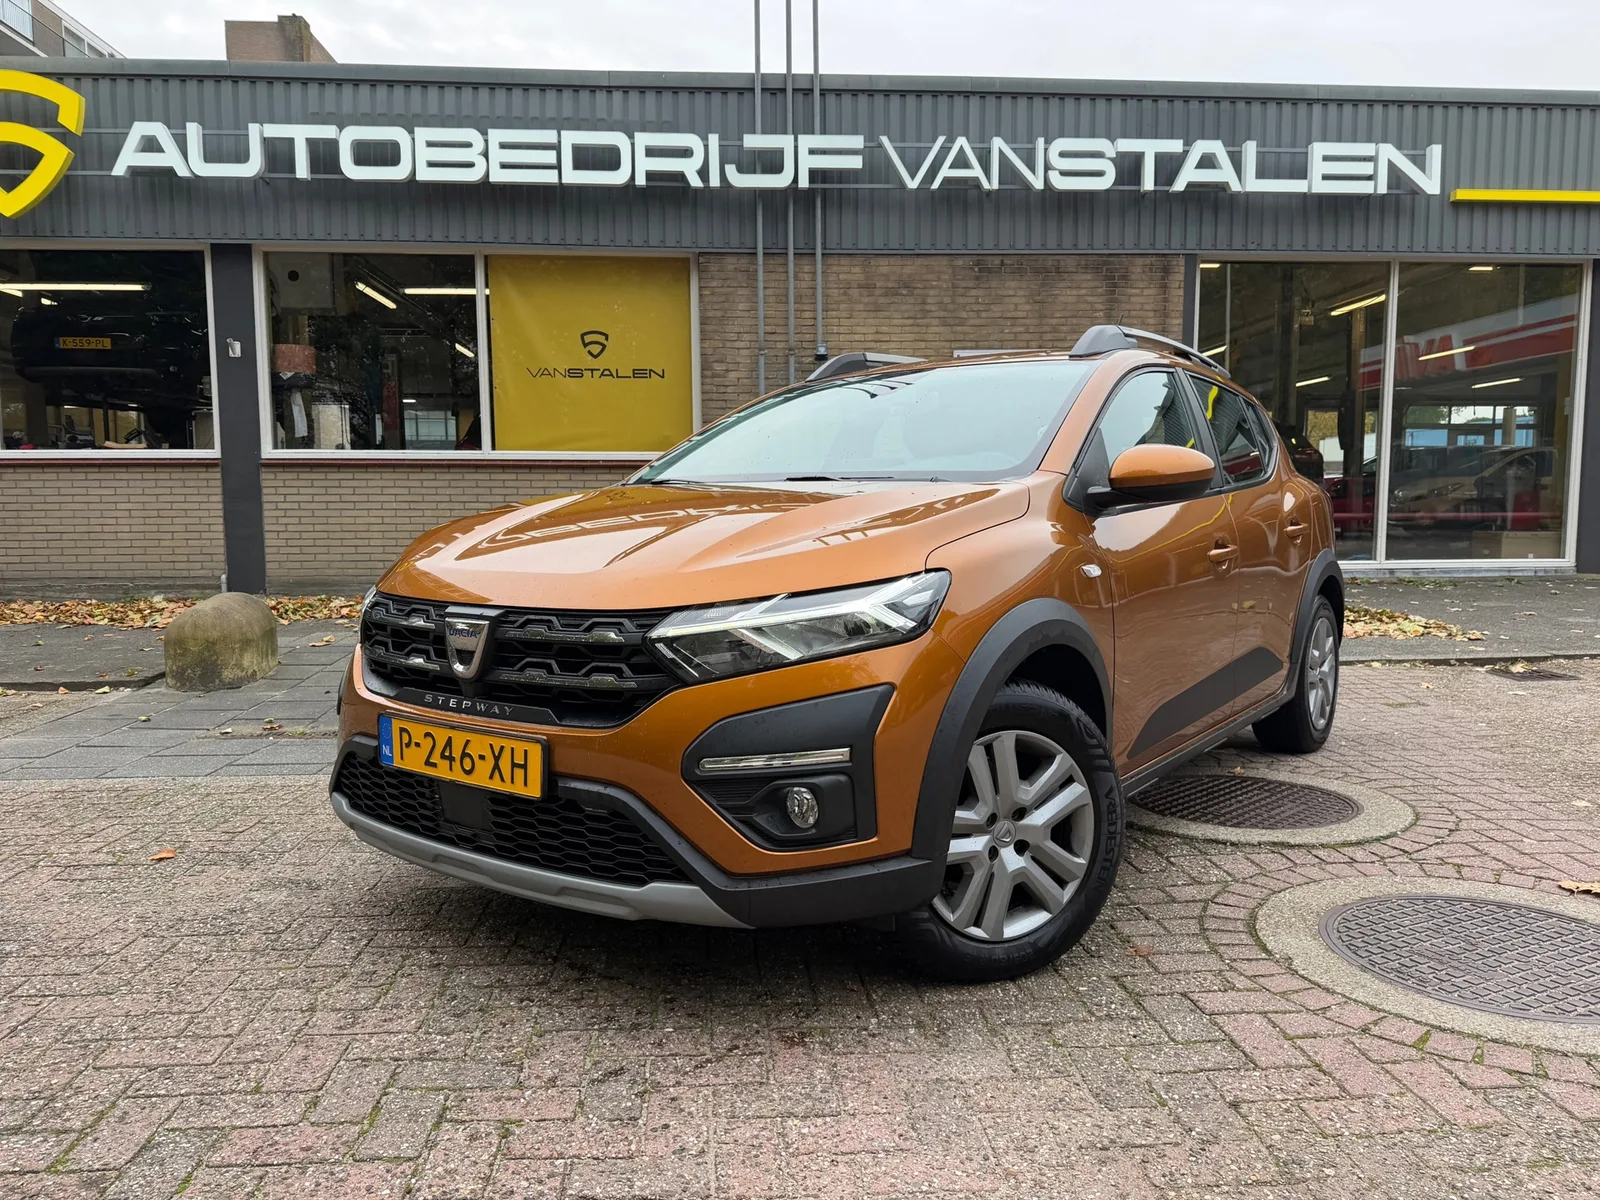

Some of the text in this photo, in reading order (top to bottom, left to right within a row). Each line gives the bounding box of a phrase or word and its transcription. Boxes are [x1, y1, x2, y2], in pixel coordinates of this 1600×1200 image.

[111, 120, 1443, 196] AUTOBEDRIJF VANSTALEN
[62, 338, 108, 348] K-559-PL
[526, 367, 665, 379] VANSTALEN
[448, 628, 478, 639] DACIA
[424, 693, 515, 717] STEPWAY
[382, 744, 393, 758] NL
[398, 725, 530, 788] P-246-XH
[1092, 785, 1118, 893] VREDESTEIN
